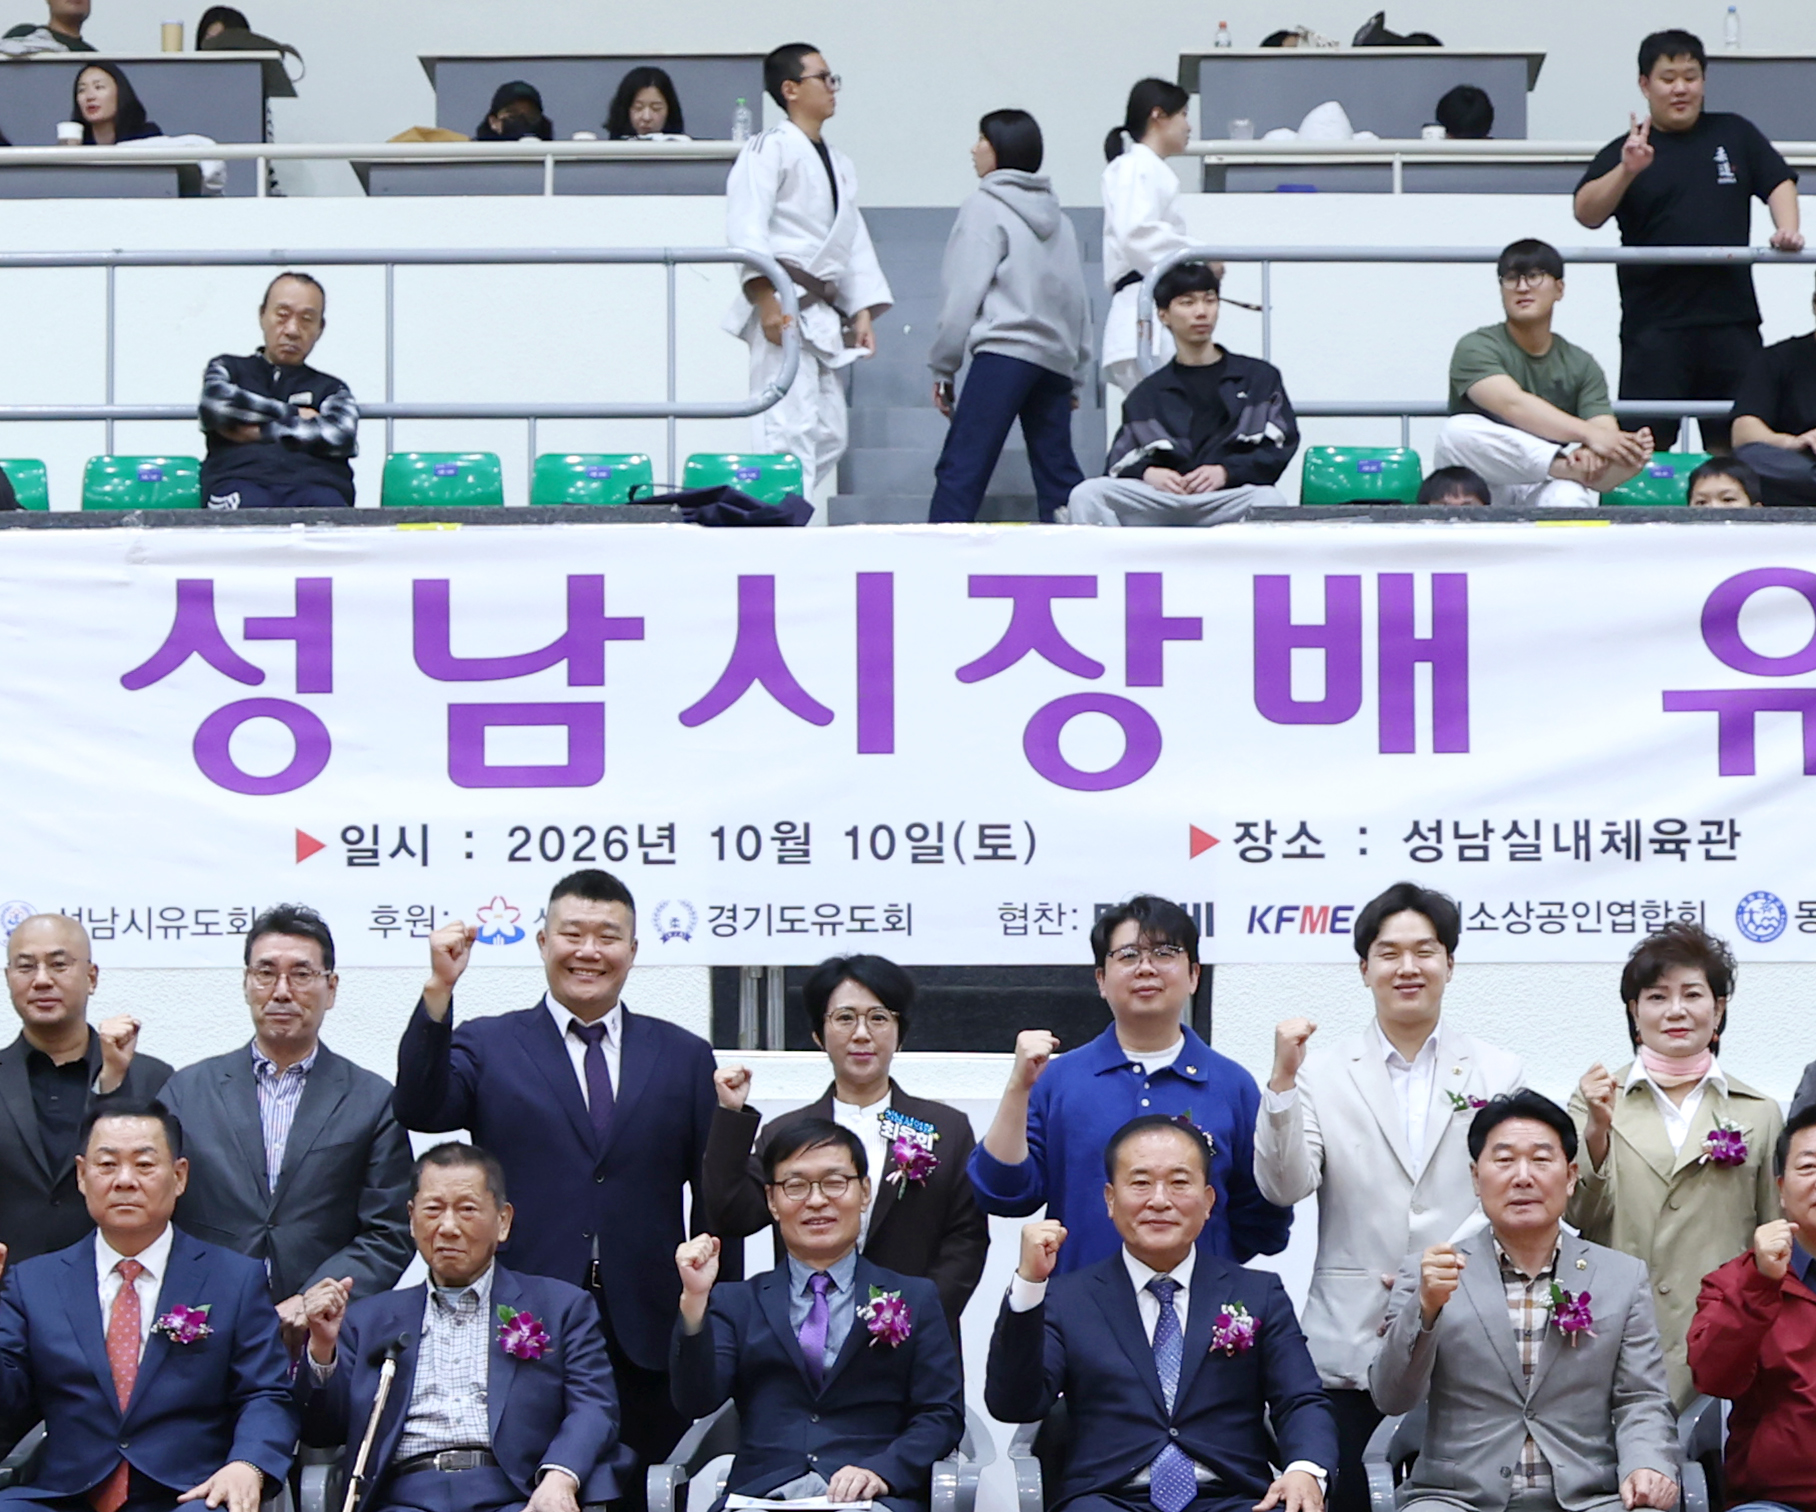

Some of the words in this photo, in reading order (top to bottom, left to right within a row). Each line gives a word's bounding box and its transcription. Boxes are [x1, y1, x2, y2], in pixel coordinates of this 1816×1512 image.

[119, 571, 1471, 796] 성남시장배
[339, 823, 429, 867] 일시
[506, 822, 677, 866] 2026년
[709, 821, 813, 866] 10월
[844, 820, 1038, 866] 10일(토)
[1232, 819, 1326, 863] 장소
[1402, 817, 1742, 863] 성남실내체육관
[706, 902, 913, 938] 경기도유도회
[997, 901, 1079, 937] 협찬:
[1246, 904, 1356, 935] KFME
[1457, 899, 1707, 935] 소상공인엽합회
